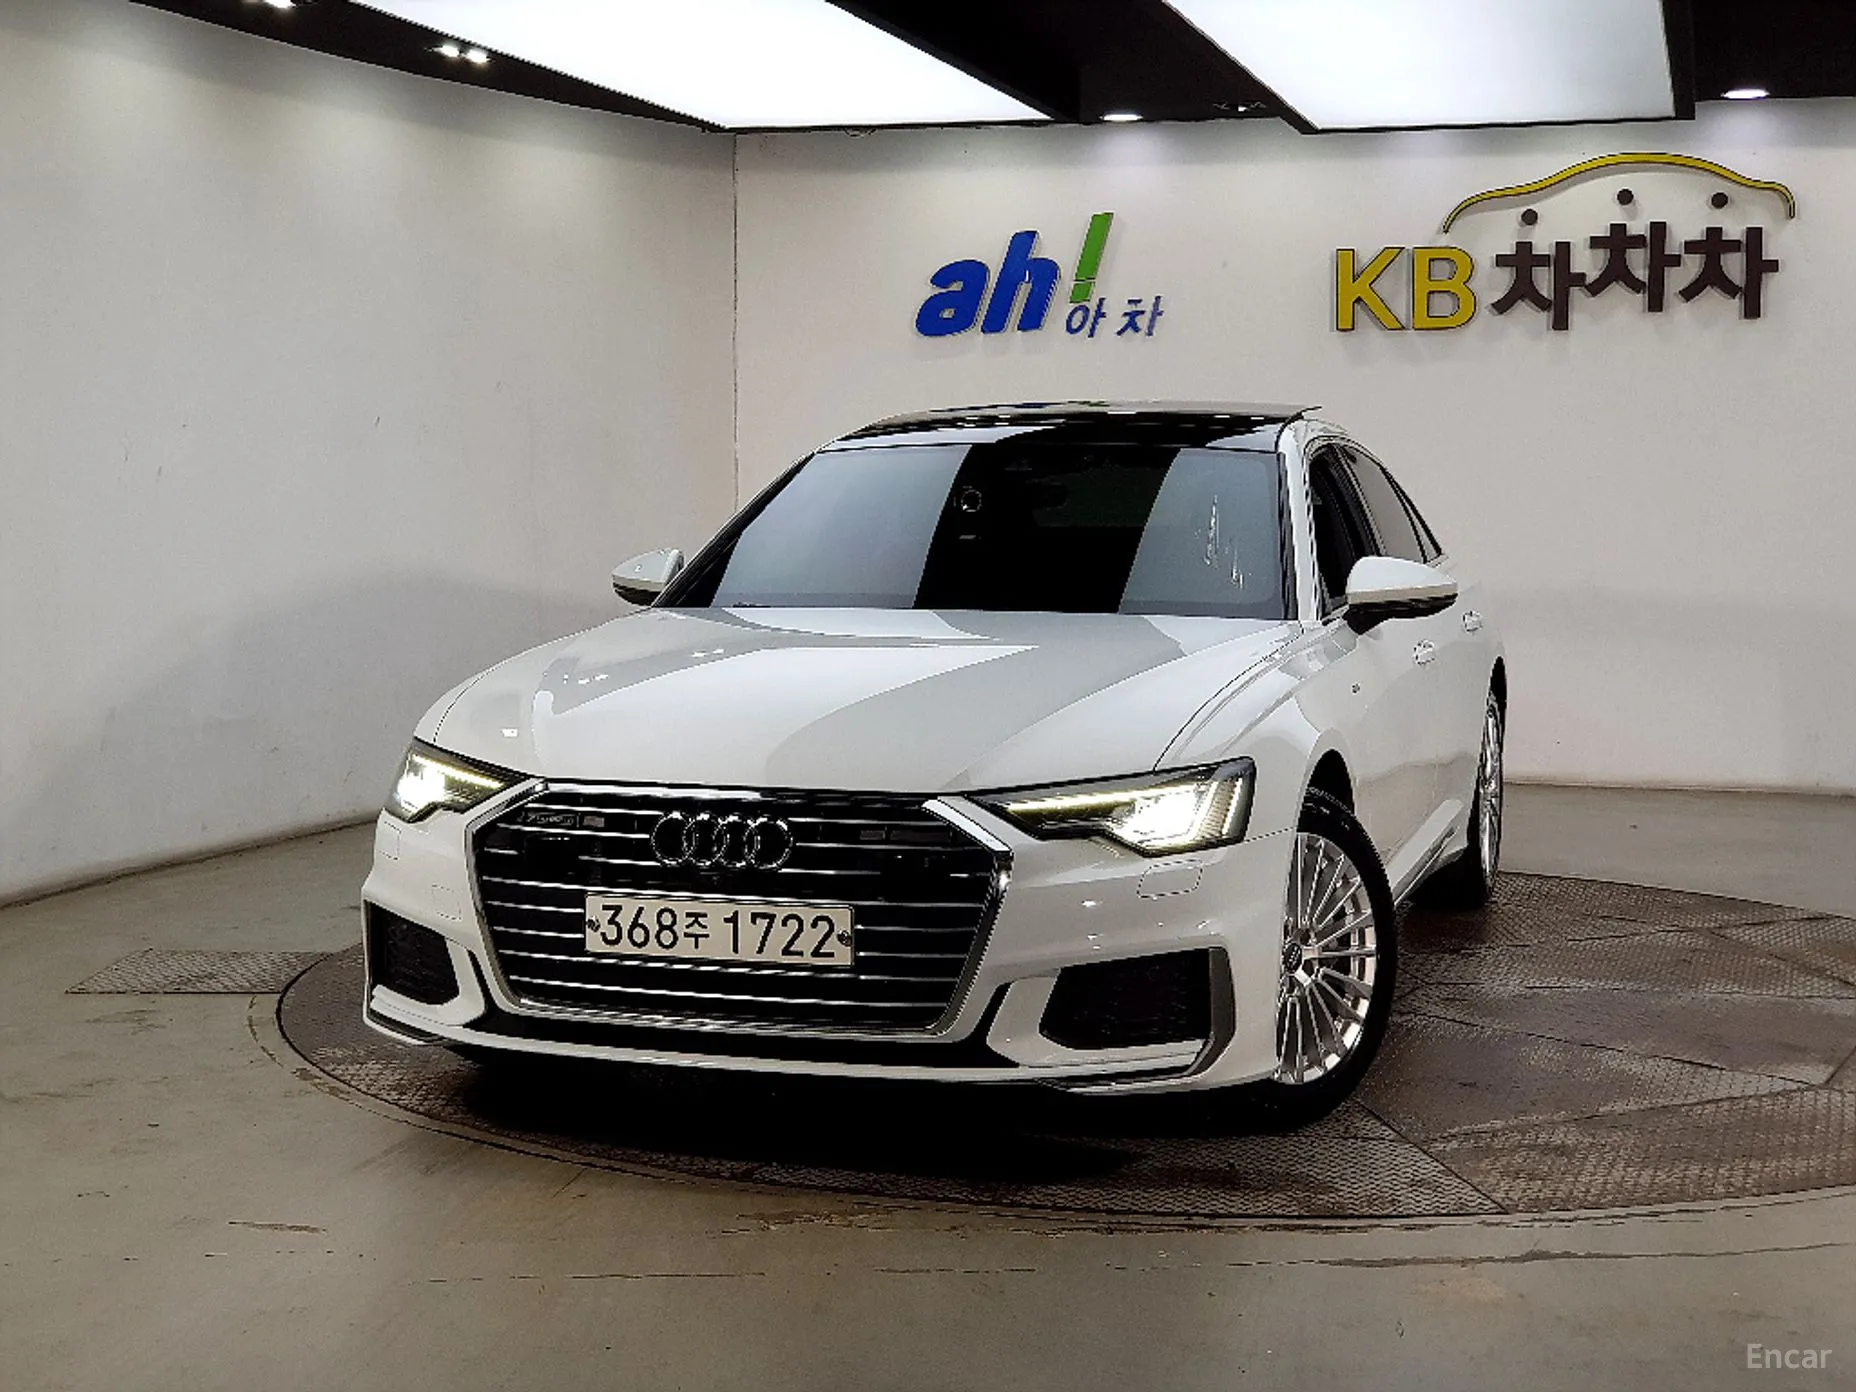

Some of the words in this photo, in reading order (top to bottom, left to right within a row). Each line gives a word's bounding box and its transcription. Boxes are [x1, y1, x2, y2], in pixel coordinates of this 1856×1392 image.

[915, 212, 1113, 337] ah!
[600, 904, 710, 950] 368주
[723, 910, 836, 958] 1722
